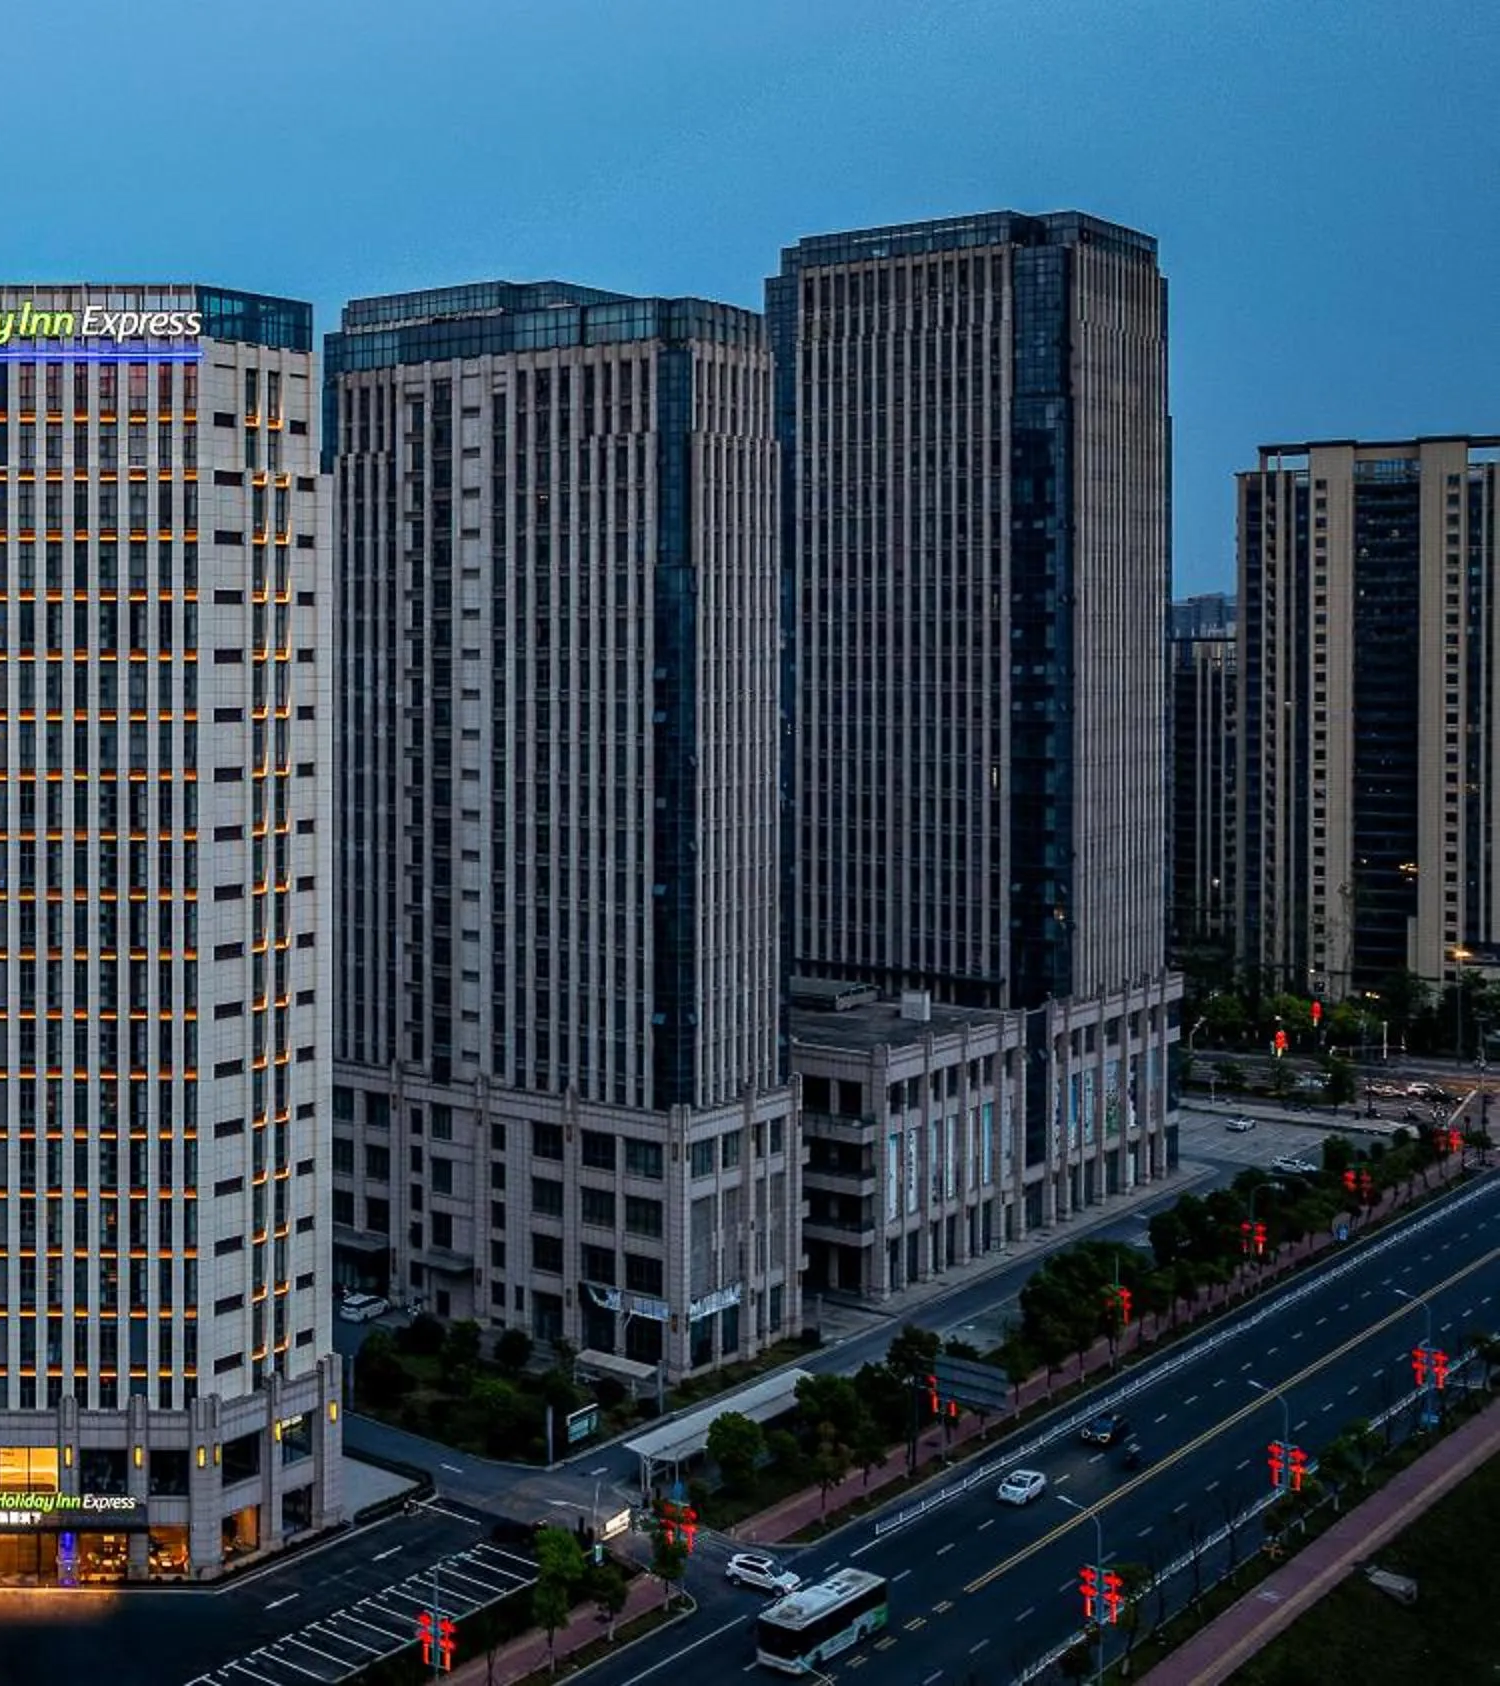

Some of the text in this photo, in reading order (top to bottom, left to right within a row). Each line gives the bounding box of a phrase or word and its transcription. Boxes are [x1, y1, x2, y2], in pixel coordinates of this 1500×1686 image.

[19, 301, 74, 336] Inn
[81, 305, 202, 343] Express
[55, 1491, 81, 1508] Inn
[82, 1493, 136, 1513] Express
